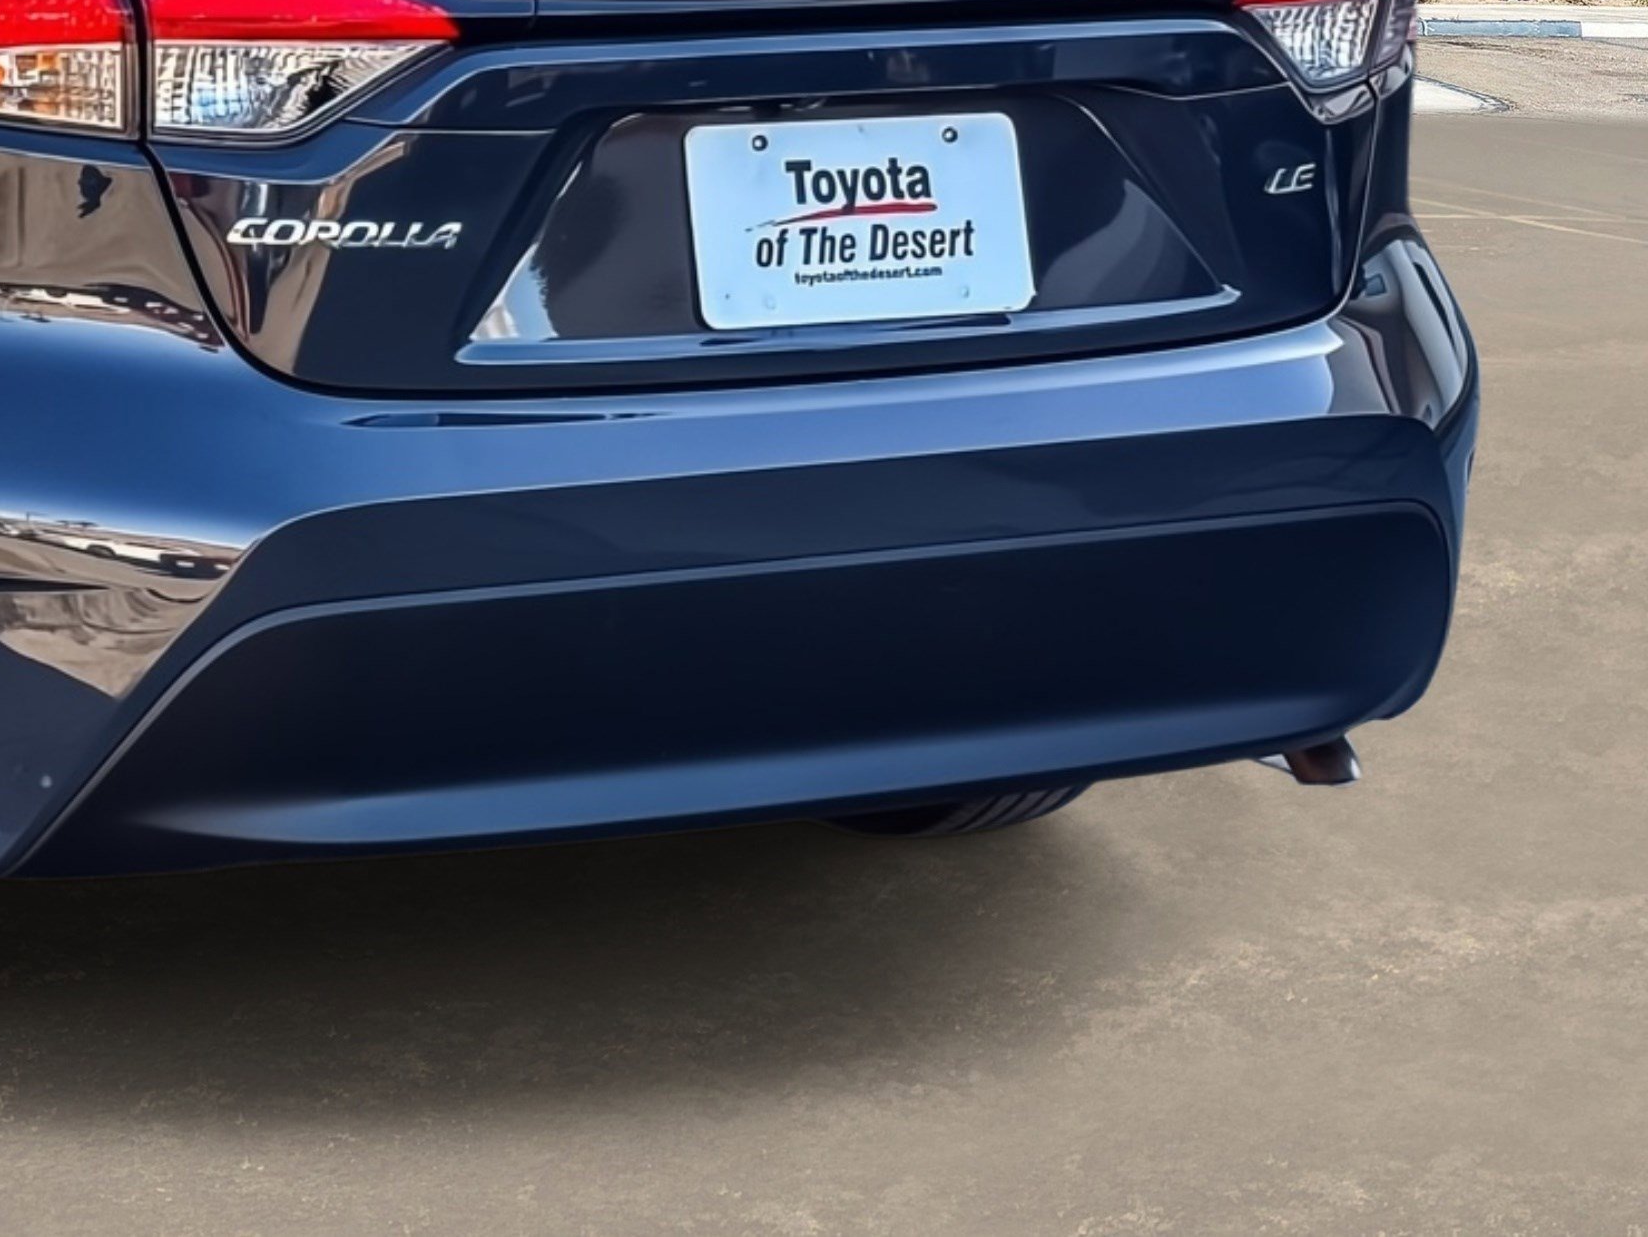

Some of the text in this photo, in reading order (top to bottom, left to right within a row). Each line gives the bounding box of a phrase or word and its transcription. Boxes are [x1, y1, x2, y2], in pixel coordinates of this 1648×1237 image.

[784, 157, 932, 212] Toyota
[1263, 163, 1316, 194] LE
[226, 217, 463, 249] COROLLA
[756, 220, 974, 267] of The Desert
[794, 266, 943, 287] toyotaofthedesert.com
